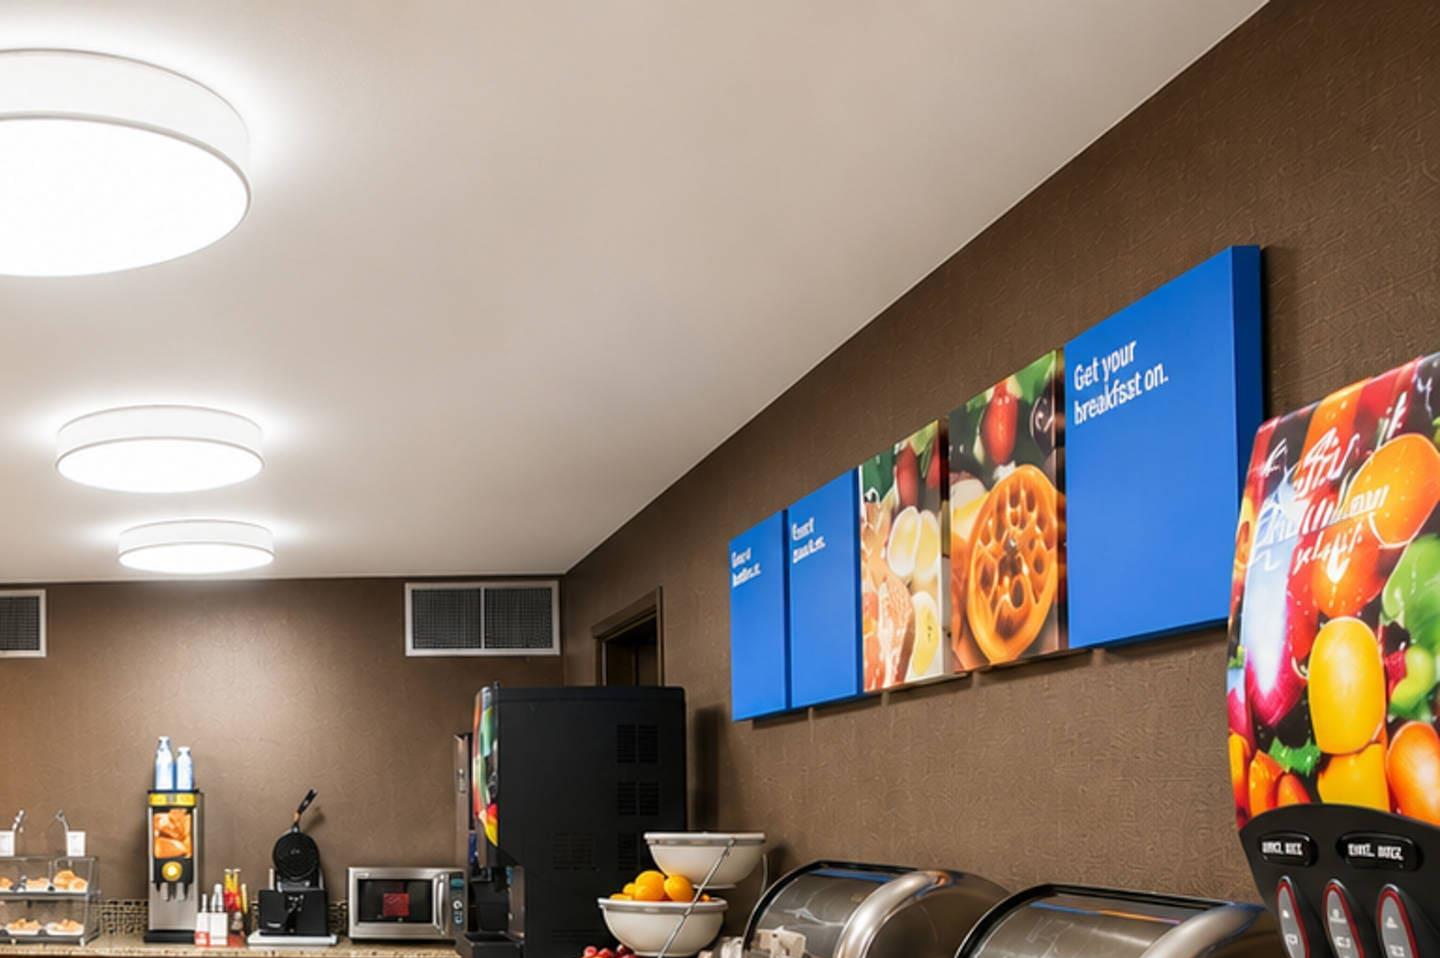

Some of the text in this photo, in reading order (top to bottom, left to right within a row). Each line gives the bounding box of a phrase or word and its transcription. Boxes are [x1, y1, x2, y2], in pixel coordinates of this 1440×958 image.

[1074, 340, 1137, 391] Get your
[1144, 363, 1169, 391] on.
